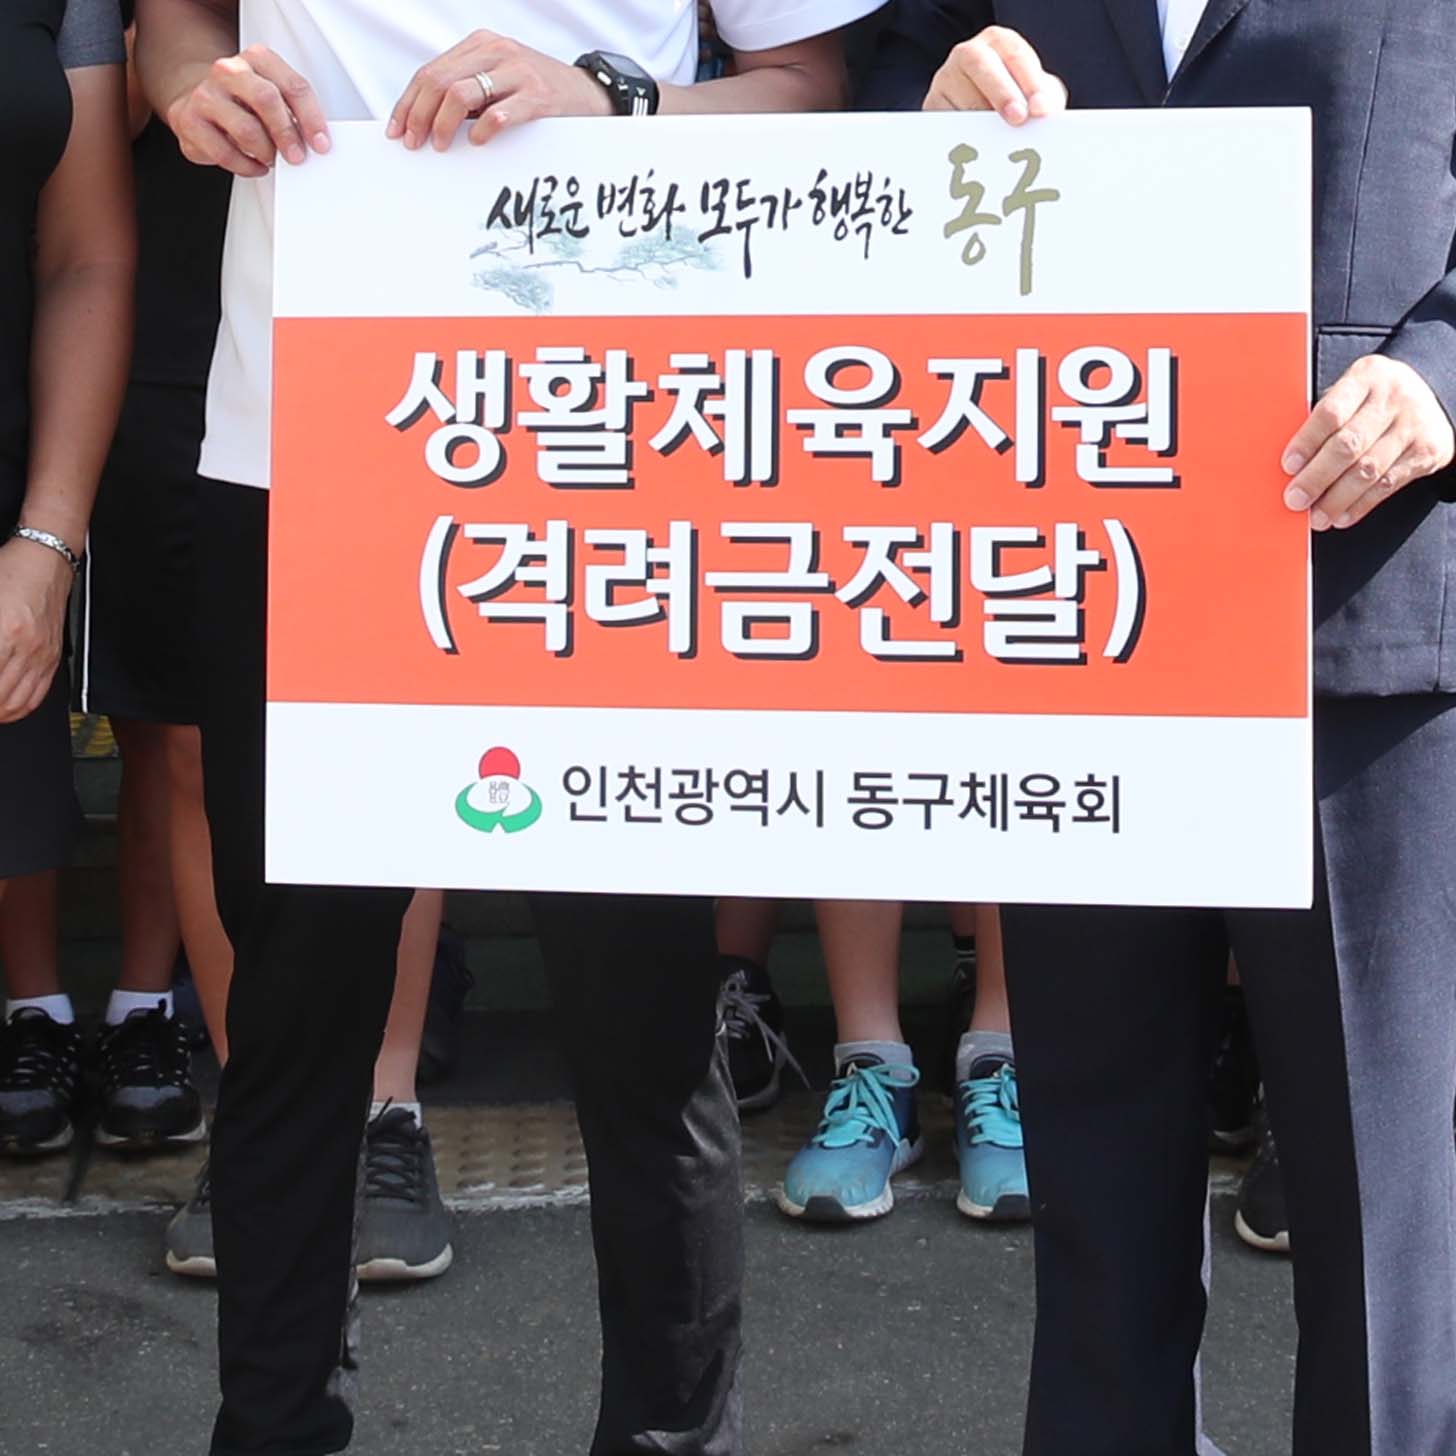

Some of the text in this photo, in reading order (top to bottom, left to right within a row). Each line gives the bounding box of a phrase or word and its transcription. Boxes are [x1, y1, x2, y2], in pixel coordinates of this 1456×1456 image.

[486, 142, 1061, 297] 새로운 변화 모두가 행복한 동구
[385, 345, 1179, 489] 생활체육지원
[419, 514, 1145, 666] (격려금전달)
[563, 765, 1121, 835] 인천광역시 동구체육회
